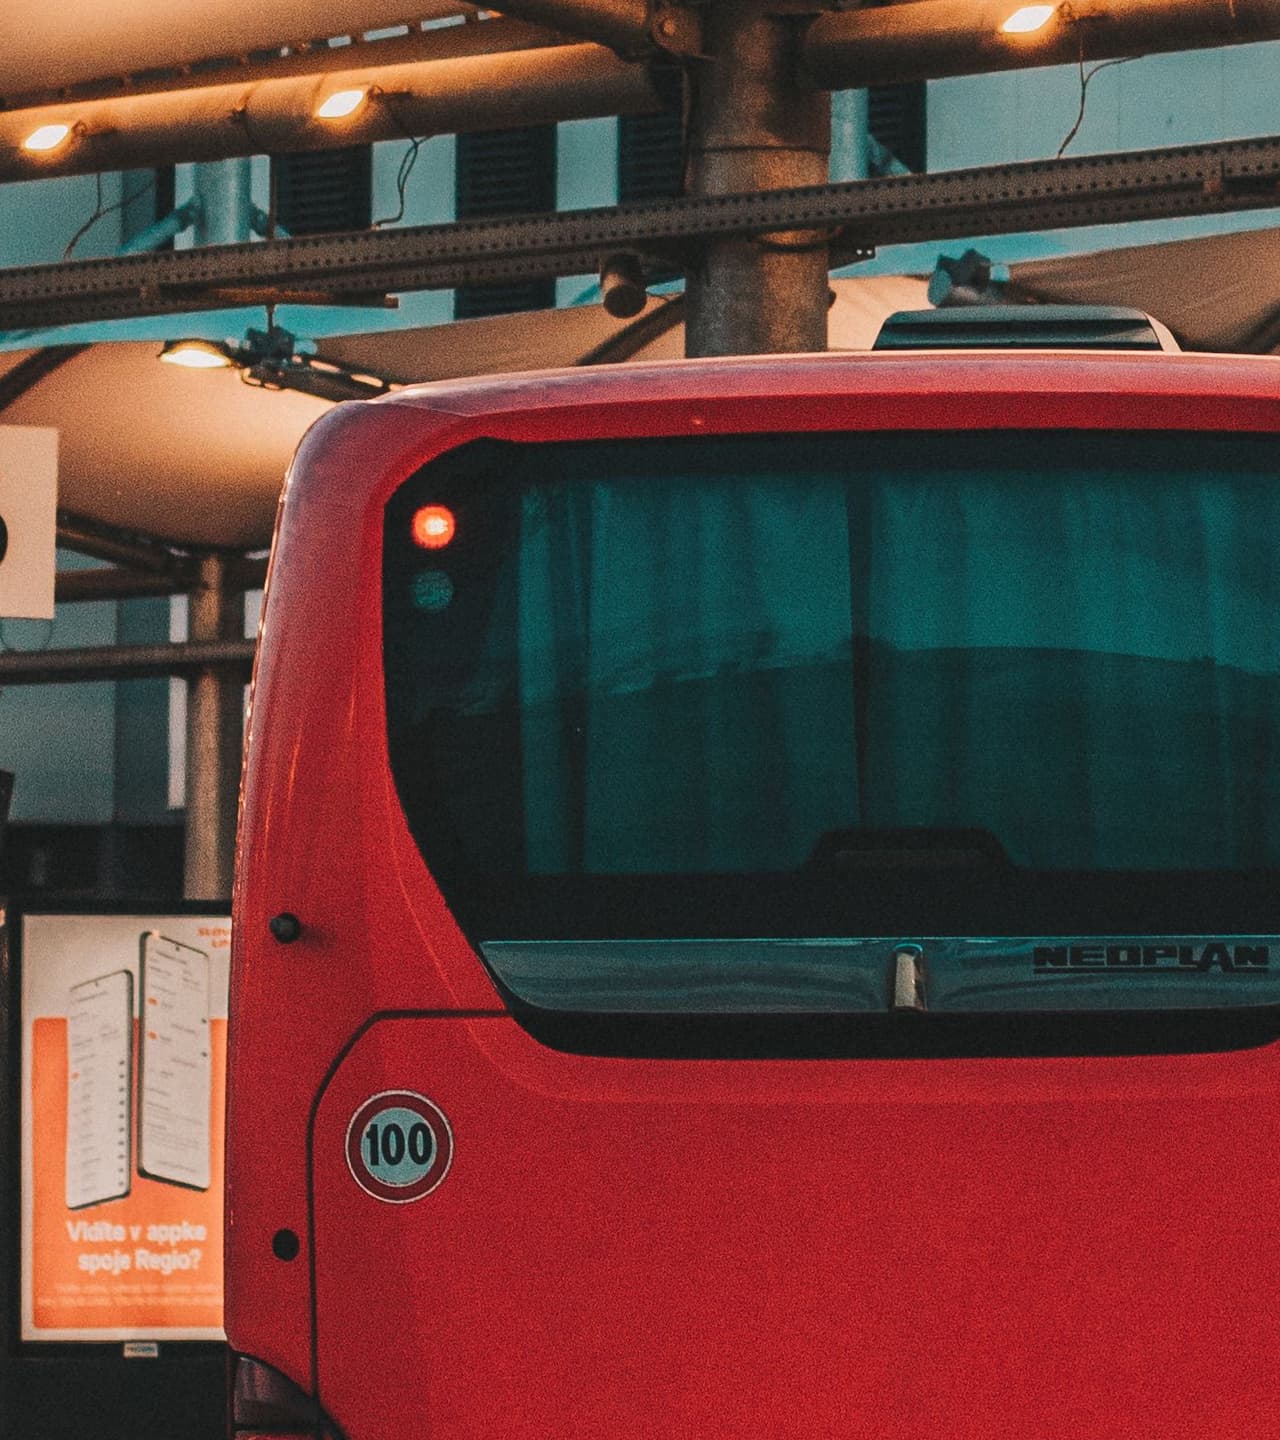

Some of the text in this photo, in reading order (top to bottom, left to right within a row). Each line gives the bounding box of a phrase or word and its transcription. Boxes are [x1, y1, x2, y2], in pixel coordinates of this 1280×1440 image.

[1033, 942, 1269, 973] NEOPLAN
[365, 1122, 433, 1166] 100
[78, 1248, 203, 1276] spoje Regio?
